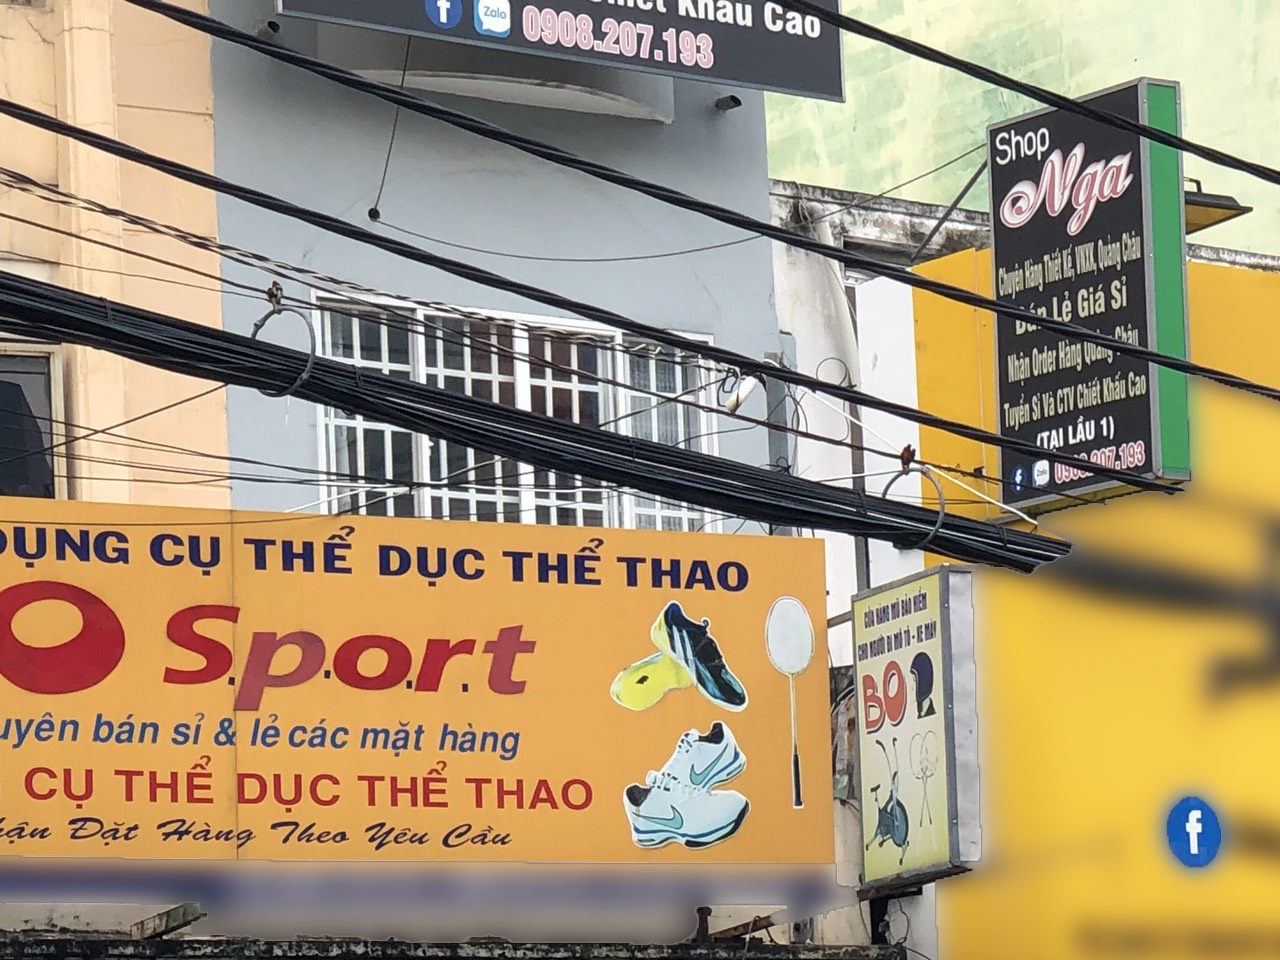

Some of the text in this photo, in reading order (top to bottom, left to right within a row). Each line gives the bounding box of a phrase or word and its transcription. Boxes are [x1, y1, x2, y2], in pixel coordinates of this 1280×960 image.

[523, 5, 714, 69] 0908.207.193
[764, 1, 822, 38] Cao
[995, 127, 1049, 166] Shop
[1000, 142, 1134, 237] Nga
[1052, 291, 1072, 322] Lẻ
[1077, 284, 1105, 318] Giá
[1110, 276, 1127, 310] Sỉ
[1032, 346, 1057, 377] Order
[1059, 340, 1082, 372] Hàng
[1043, 389, 1054, 417] Và
[1056, 386, 1074, 414] CTV
[1076, 377, 1101, 409] Chiết
[1128, 371, 1147, 398] Cao
[1068, 415, 1095, 447] LẦU
[1100, 415, 1115, 440] 1)
[149, 533, 221, 576] CỤ
[243, 526, 356, 575] THỂ
[378, 545, 486, 588] DỤC
[502, 538, 605, 586] THỂ
[616, 556, 749, 592] THAO
[862, 660, 907, 734] BO
[92, 712, 520, 761] bán sỉ & lẻ các mặt hàng
[24, 754, 593, 813] CỤ THỂ DỤC THỂ THAO
[68, 817, 139, 846] Đặt
[157, 819, 256, 849] Hàng
[270, 821, 349, 844] Theo
[364, 822, 430, 851] Yêu
[442, 823, 512, 848] Cầu
